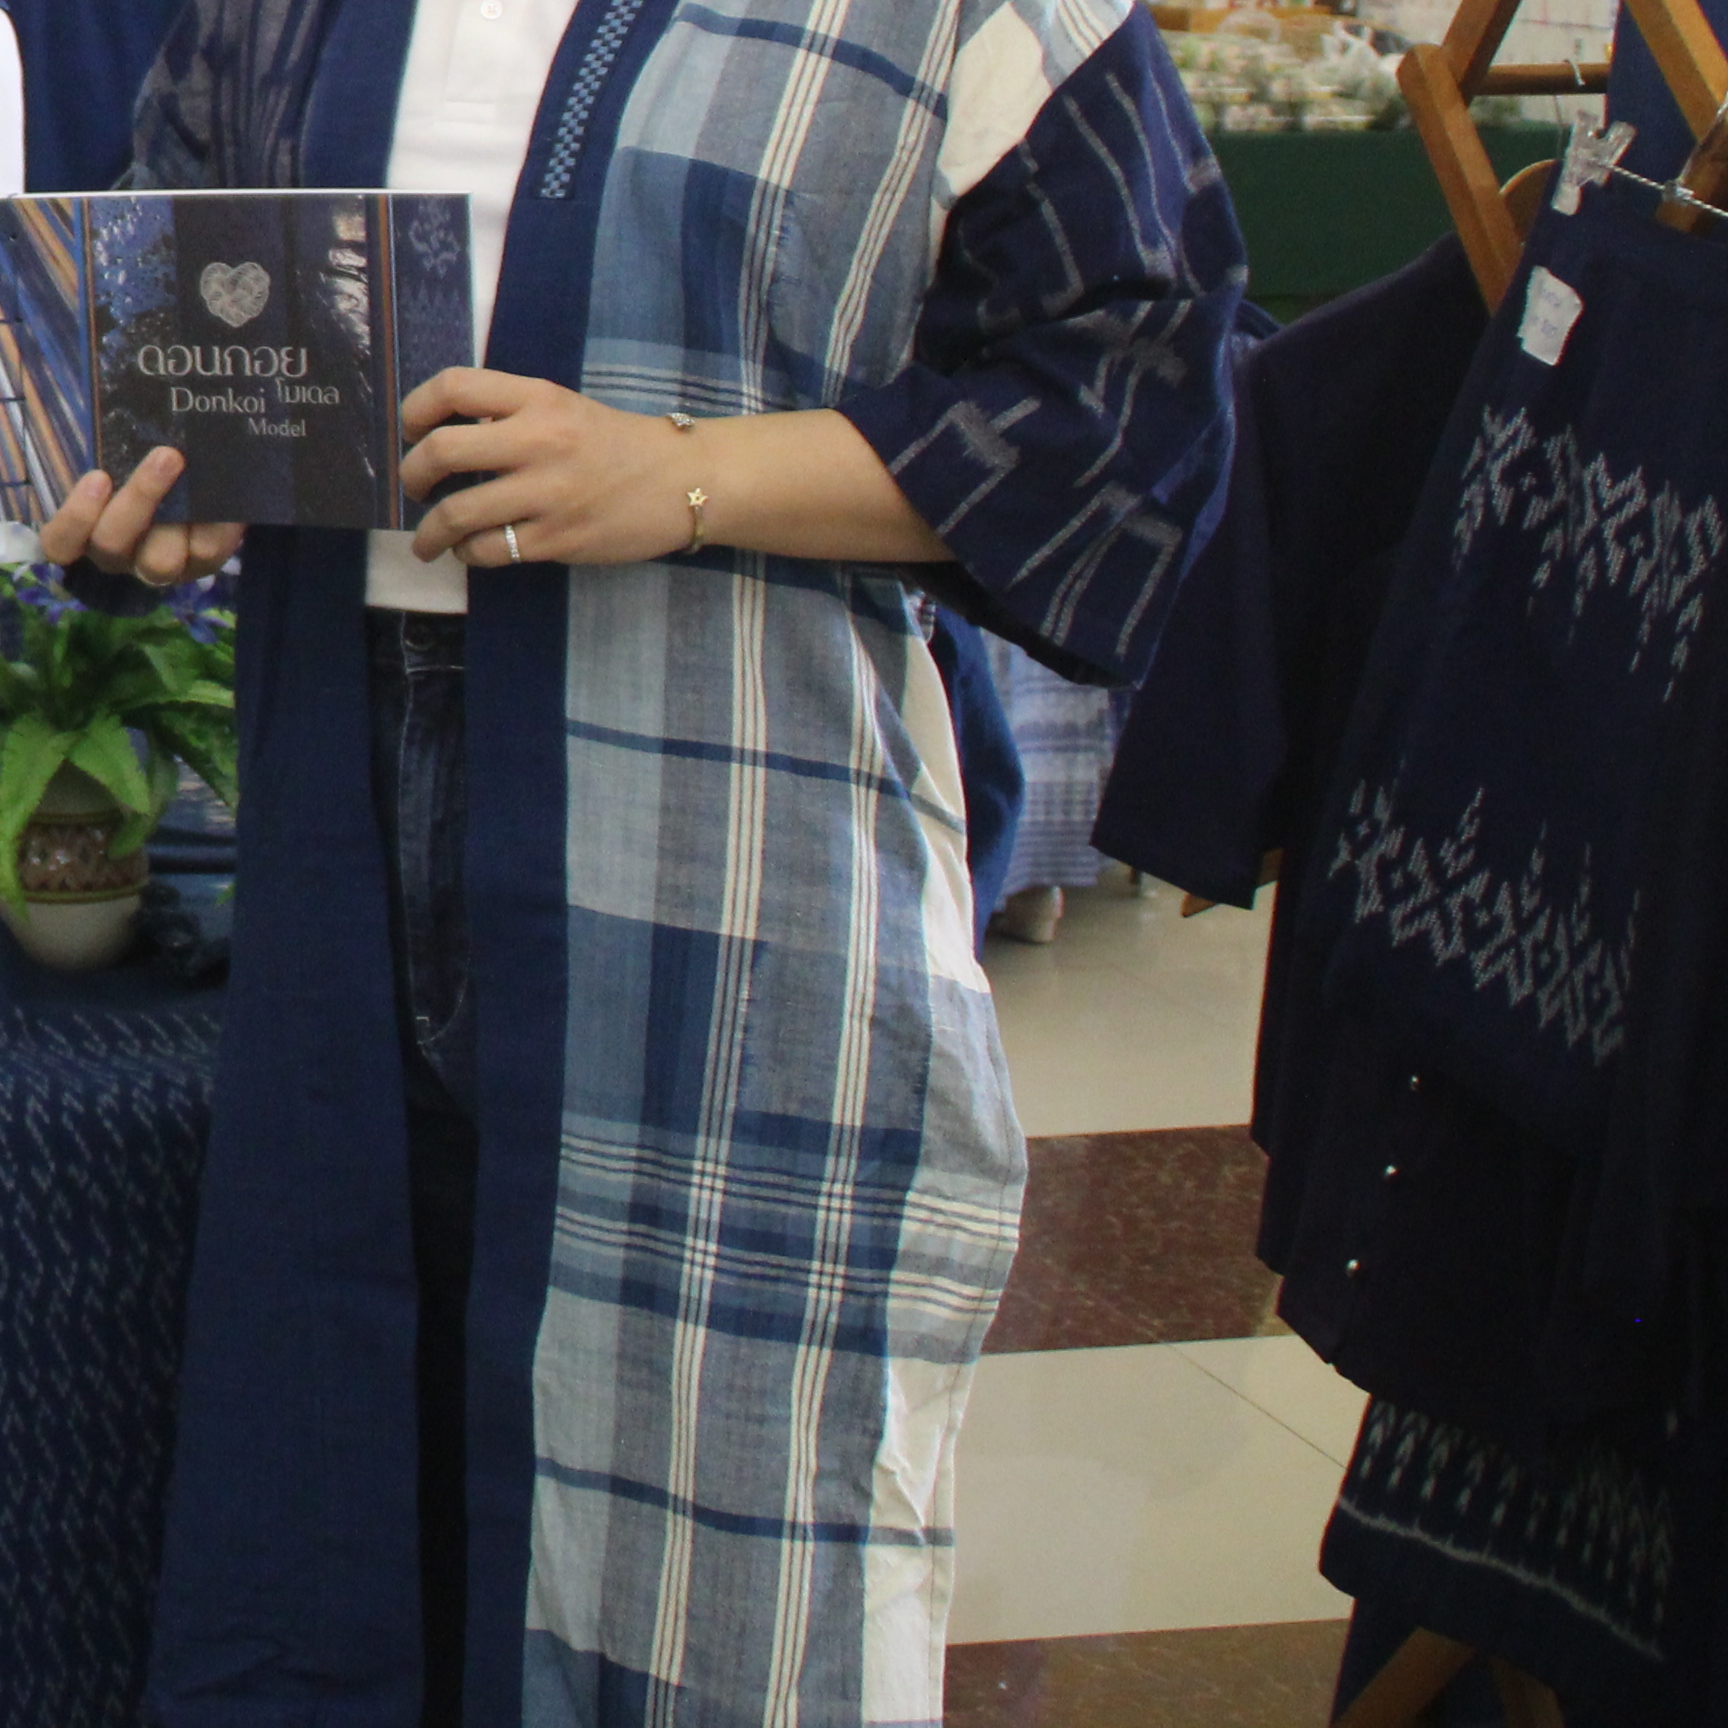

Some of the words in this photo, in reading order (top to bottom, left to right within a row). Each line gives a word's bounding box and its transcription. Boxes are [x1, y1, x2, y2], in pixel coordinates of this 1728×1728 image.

[137, 344, 308, 379] ดอนกอย
[170, 386, 266, 414] Donkoi
[275, 377, 341, 405] โมเดล
[247, 417, 307, 437] Model
